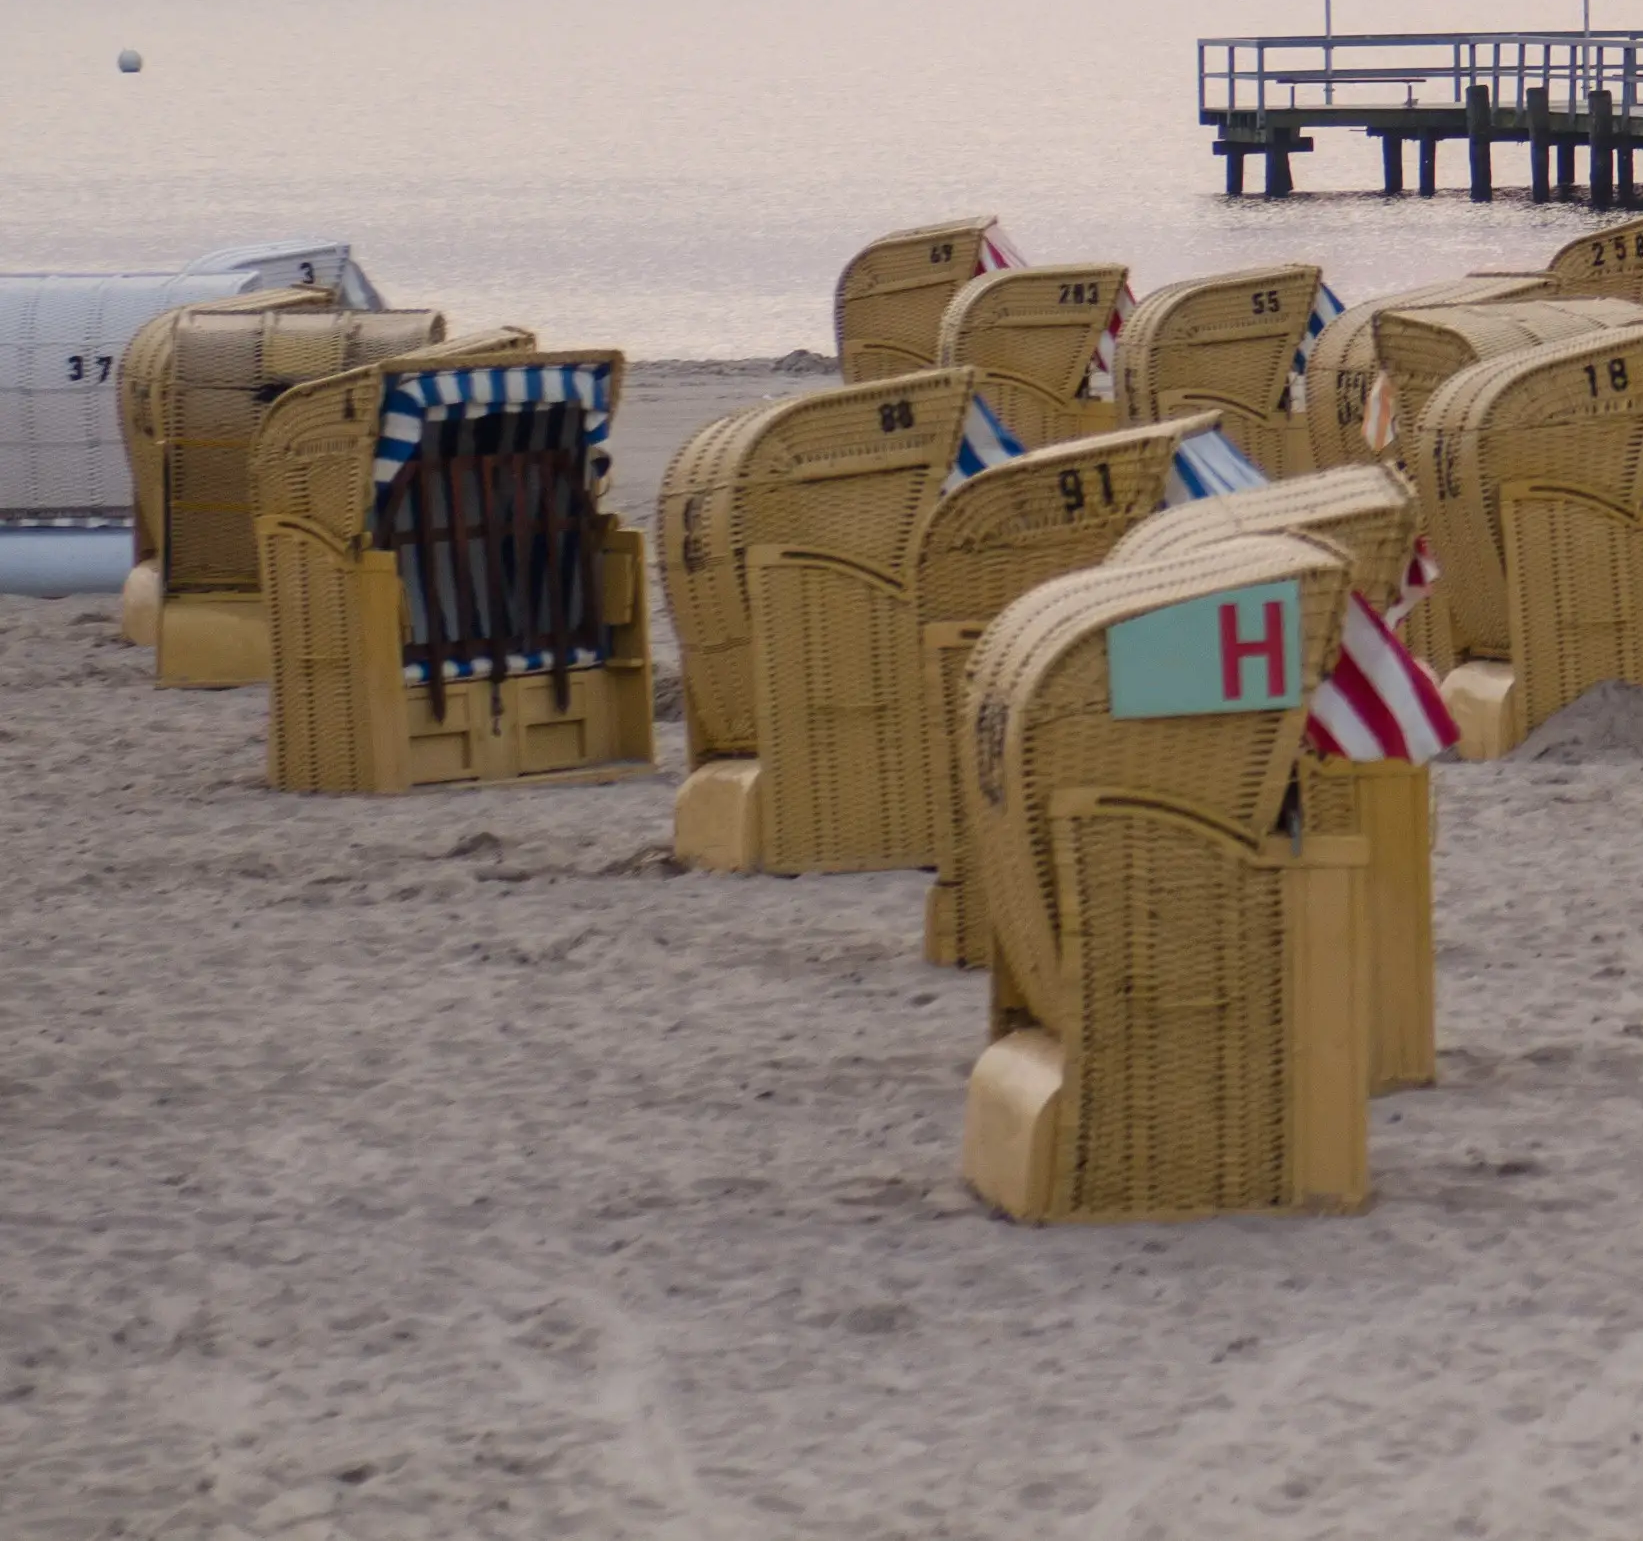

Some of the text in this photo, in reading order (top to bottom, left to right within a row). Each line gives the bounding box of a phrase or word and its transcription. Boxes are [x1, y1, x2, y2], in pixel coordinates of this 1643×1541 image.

[300, 262, 315, 285] 3
[1252, 290, 1281, 316] 55
[68, 355, 113, 384] 37
[1584, 357, 1628, 398] 18
[1058, 461, 1116, 514] 91
[1218, 600, 1286, 702] H
